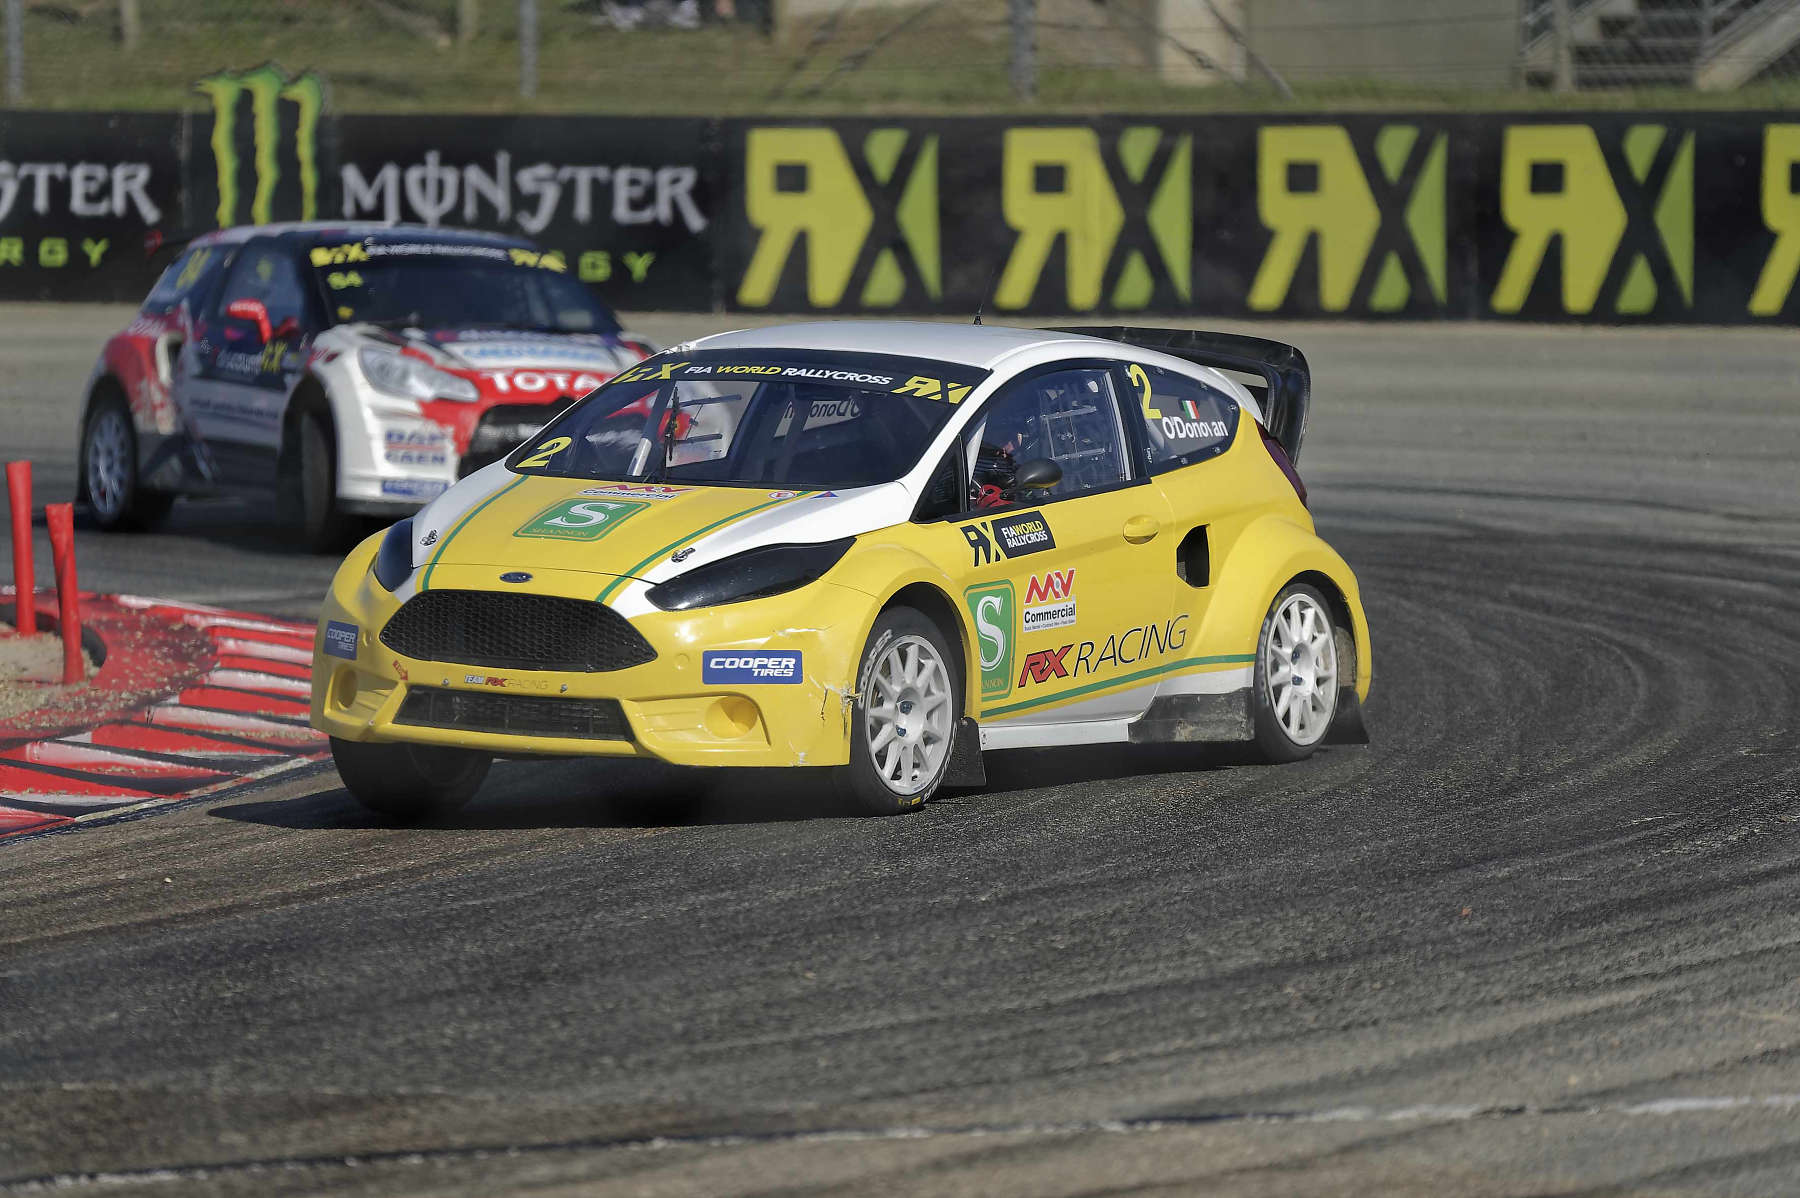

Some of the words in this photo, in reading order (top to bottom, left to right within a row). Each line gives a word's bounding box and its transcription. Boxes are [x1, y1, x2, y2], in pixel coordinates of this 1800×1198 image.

[341, 150, 708, 233] MONSTER
[480, 369, 610, 395] TOTA
[684, 366, 713, 374] FIA
[716, 365, 782, 375] WORLD
[781, 367, 893, 385] RALLYCROSS
[1129, 363, 1163, 419] 2
[514, 436, 572, 468] 2
[583, 489, 677, 499] Commercial
[544, 502, 625, 528] S
[1006, 530, 1048, 548] RALLYCROSS
[1024, 603, 1076, 624] Commercial
[976, 595, 1006, 672] S
[709, 657, 796, 669] COOPER
[1017, 643, 1075, 689] RX
[1073, 614, 1189, 678] RACING
[751, 668, 794, 677] TIRES
